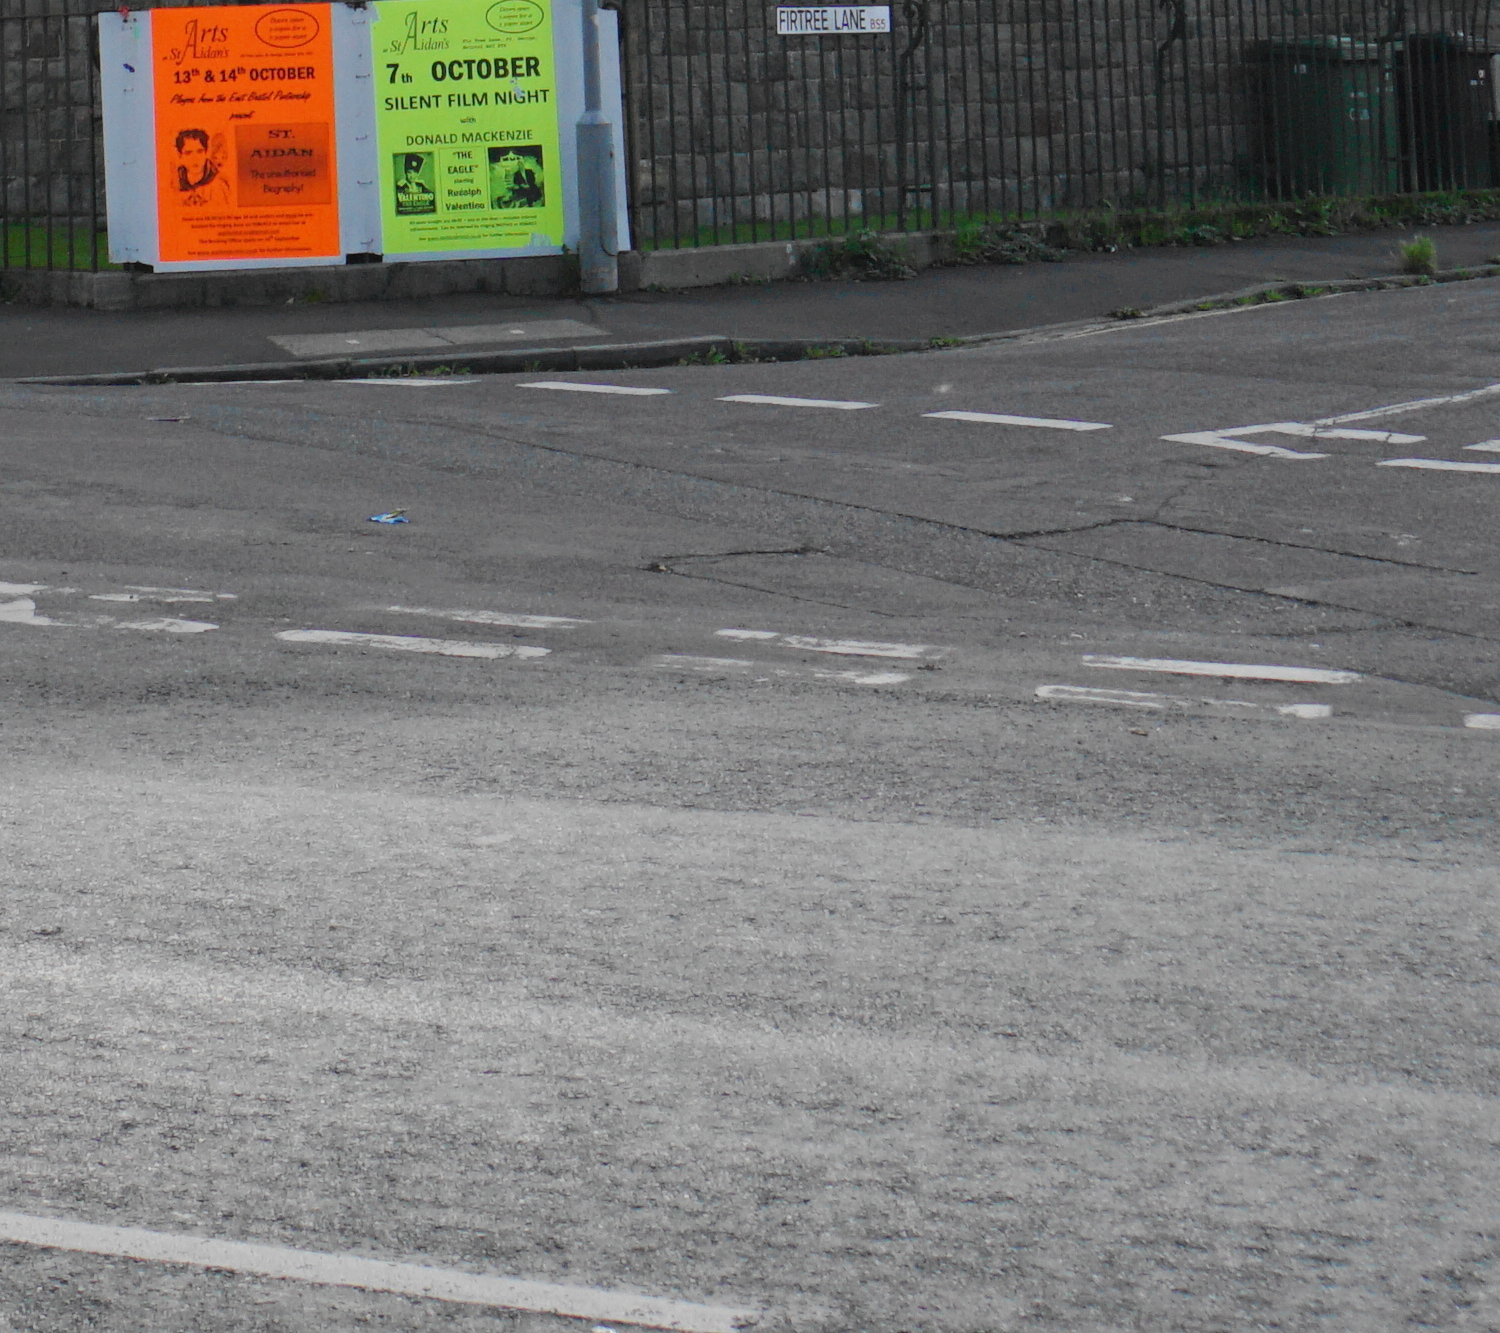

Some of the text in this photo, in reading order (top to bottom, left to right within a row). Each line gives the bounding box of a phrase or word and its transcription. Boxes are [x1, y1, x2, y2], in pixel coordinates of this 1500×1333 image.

[780, 9, 886, 31] FIRTREE LANE BS5
[405, 11, 448, 43] Arts
[174, 66, 315, 84] 13th & 14th OCTOBER
[431, 57, 540, 82] OCTOBER
[229, 92, 245, 103] East
[248, 91, 274, 102] Bristol
[385, 89, 550, 111] SILENT FILM NIGHT
[269, 129, 295, 138] ST.
[406, 130, 534, 146] DONALD MACKENZIE
[251, 148, 313, 158] AIDAN
[452, 151, 473, 160] "THE
[251, 169, 265, 179] The
[448, 164, 478, 174] EAGLE"
[445, 201, 485, 211] Valentino
